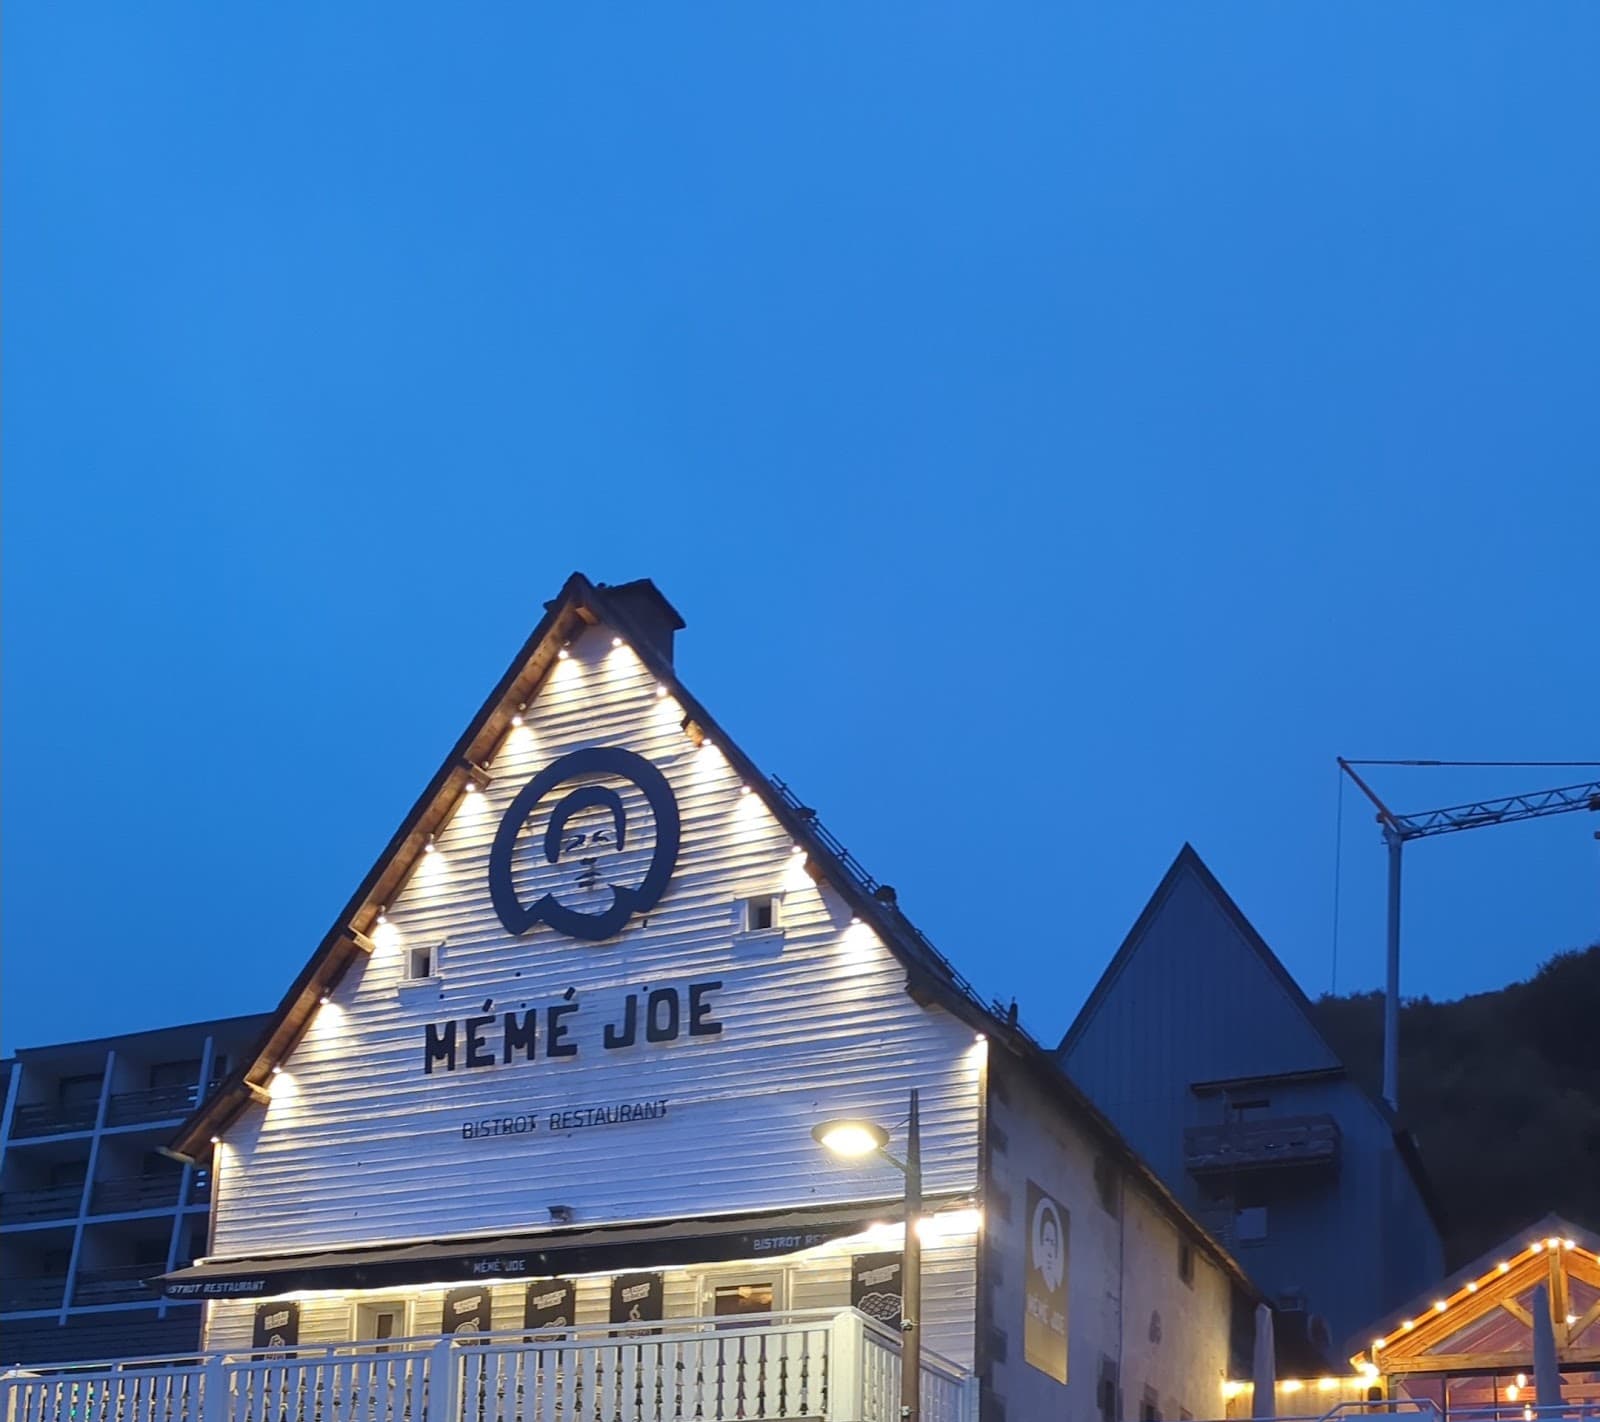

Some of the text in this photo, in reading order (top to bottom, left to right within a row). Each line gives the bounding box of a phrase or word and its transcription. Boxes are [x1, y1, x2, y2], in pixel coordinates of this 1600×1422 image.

[425, 981, 723, 1074] MÉMÉ JOE
[462, 1100, 669, 1139] BISTROT RESTAURANT
[753, 1236, 801, 1250] BISTROT
[505, 1260, 526, 1272] JOE
